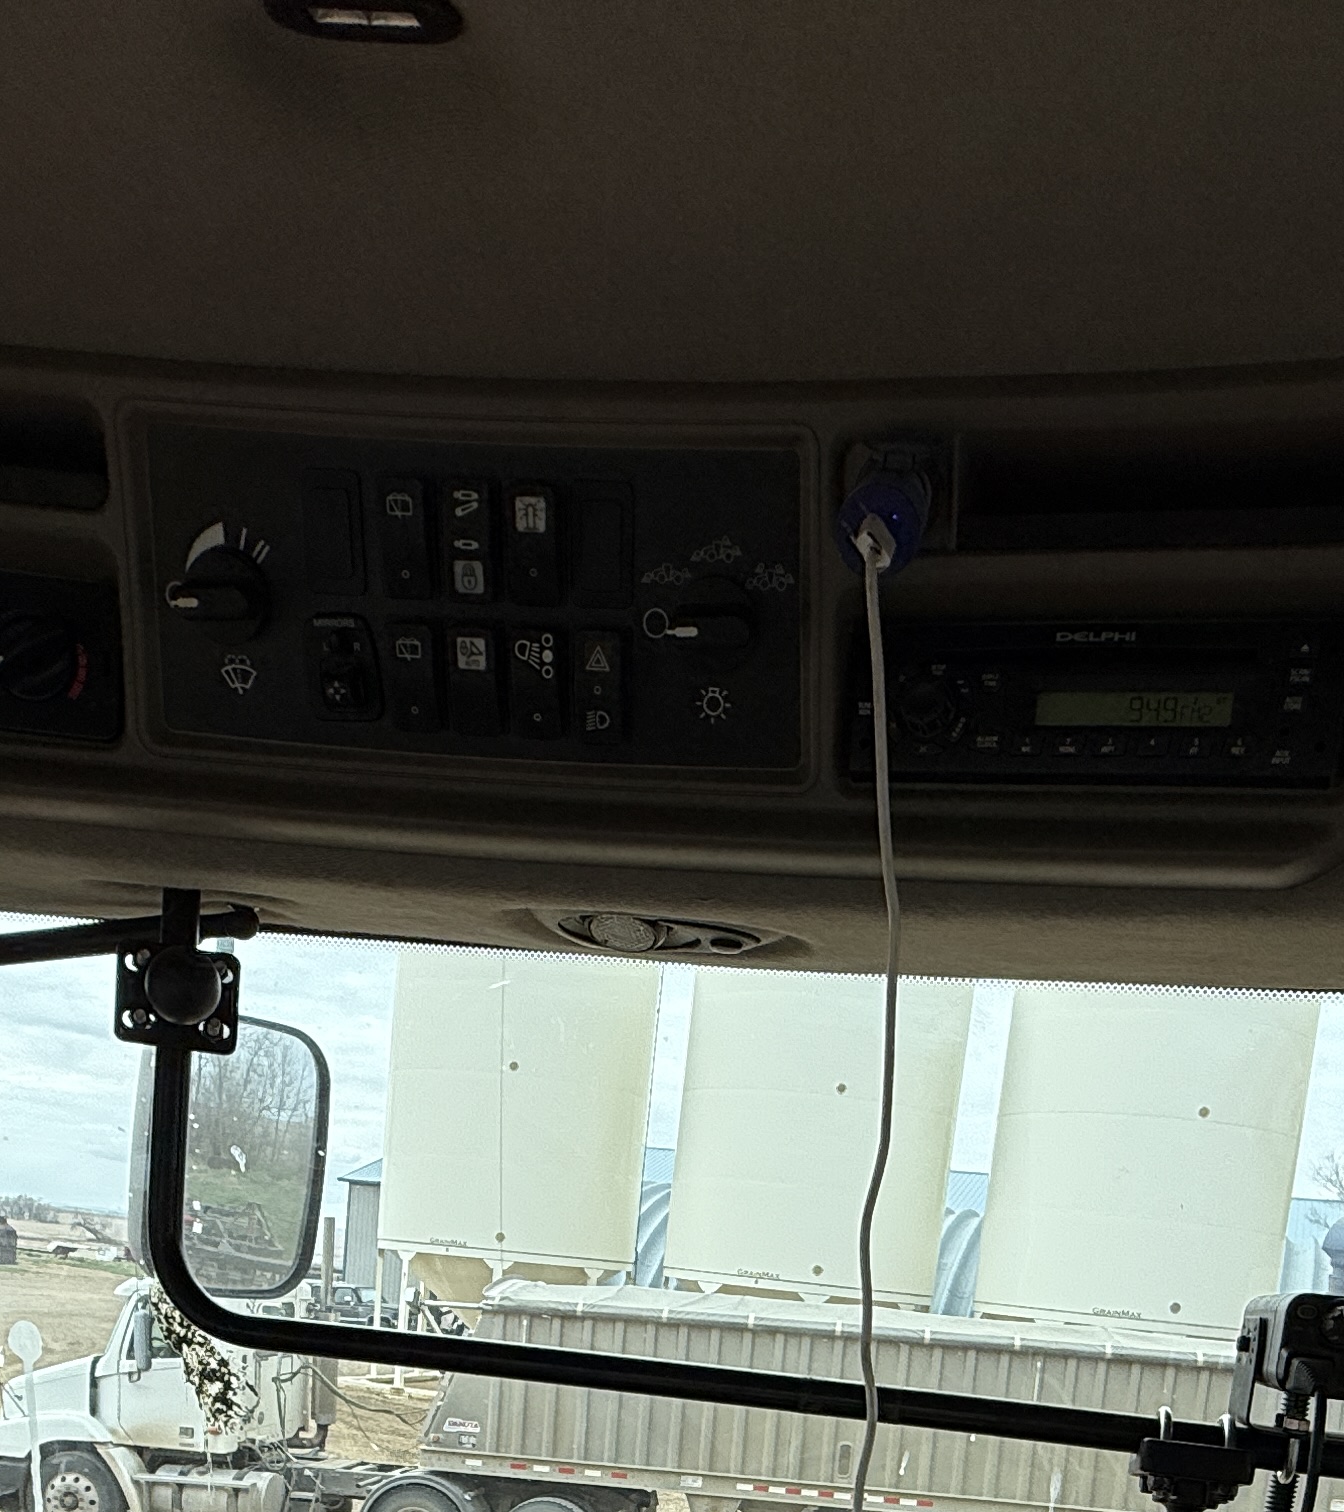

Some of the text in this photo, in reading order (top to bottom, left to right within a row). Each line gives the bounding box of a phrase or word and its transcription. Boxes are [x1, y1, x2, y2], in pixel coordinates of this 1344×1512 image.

[313, 618, 355, 628] MIRRORS
[1055, 631, 1137, 642] DELPHI
[353, 642, 361, 652] R
